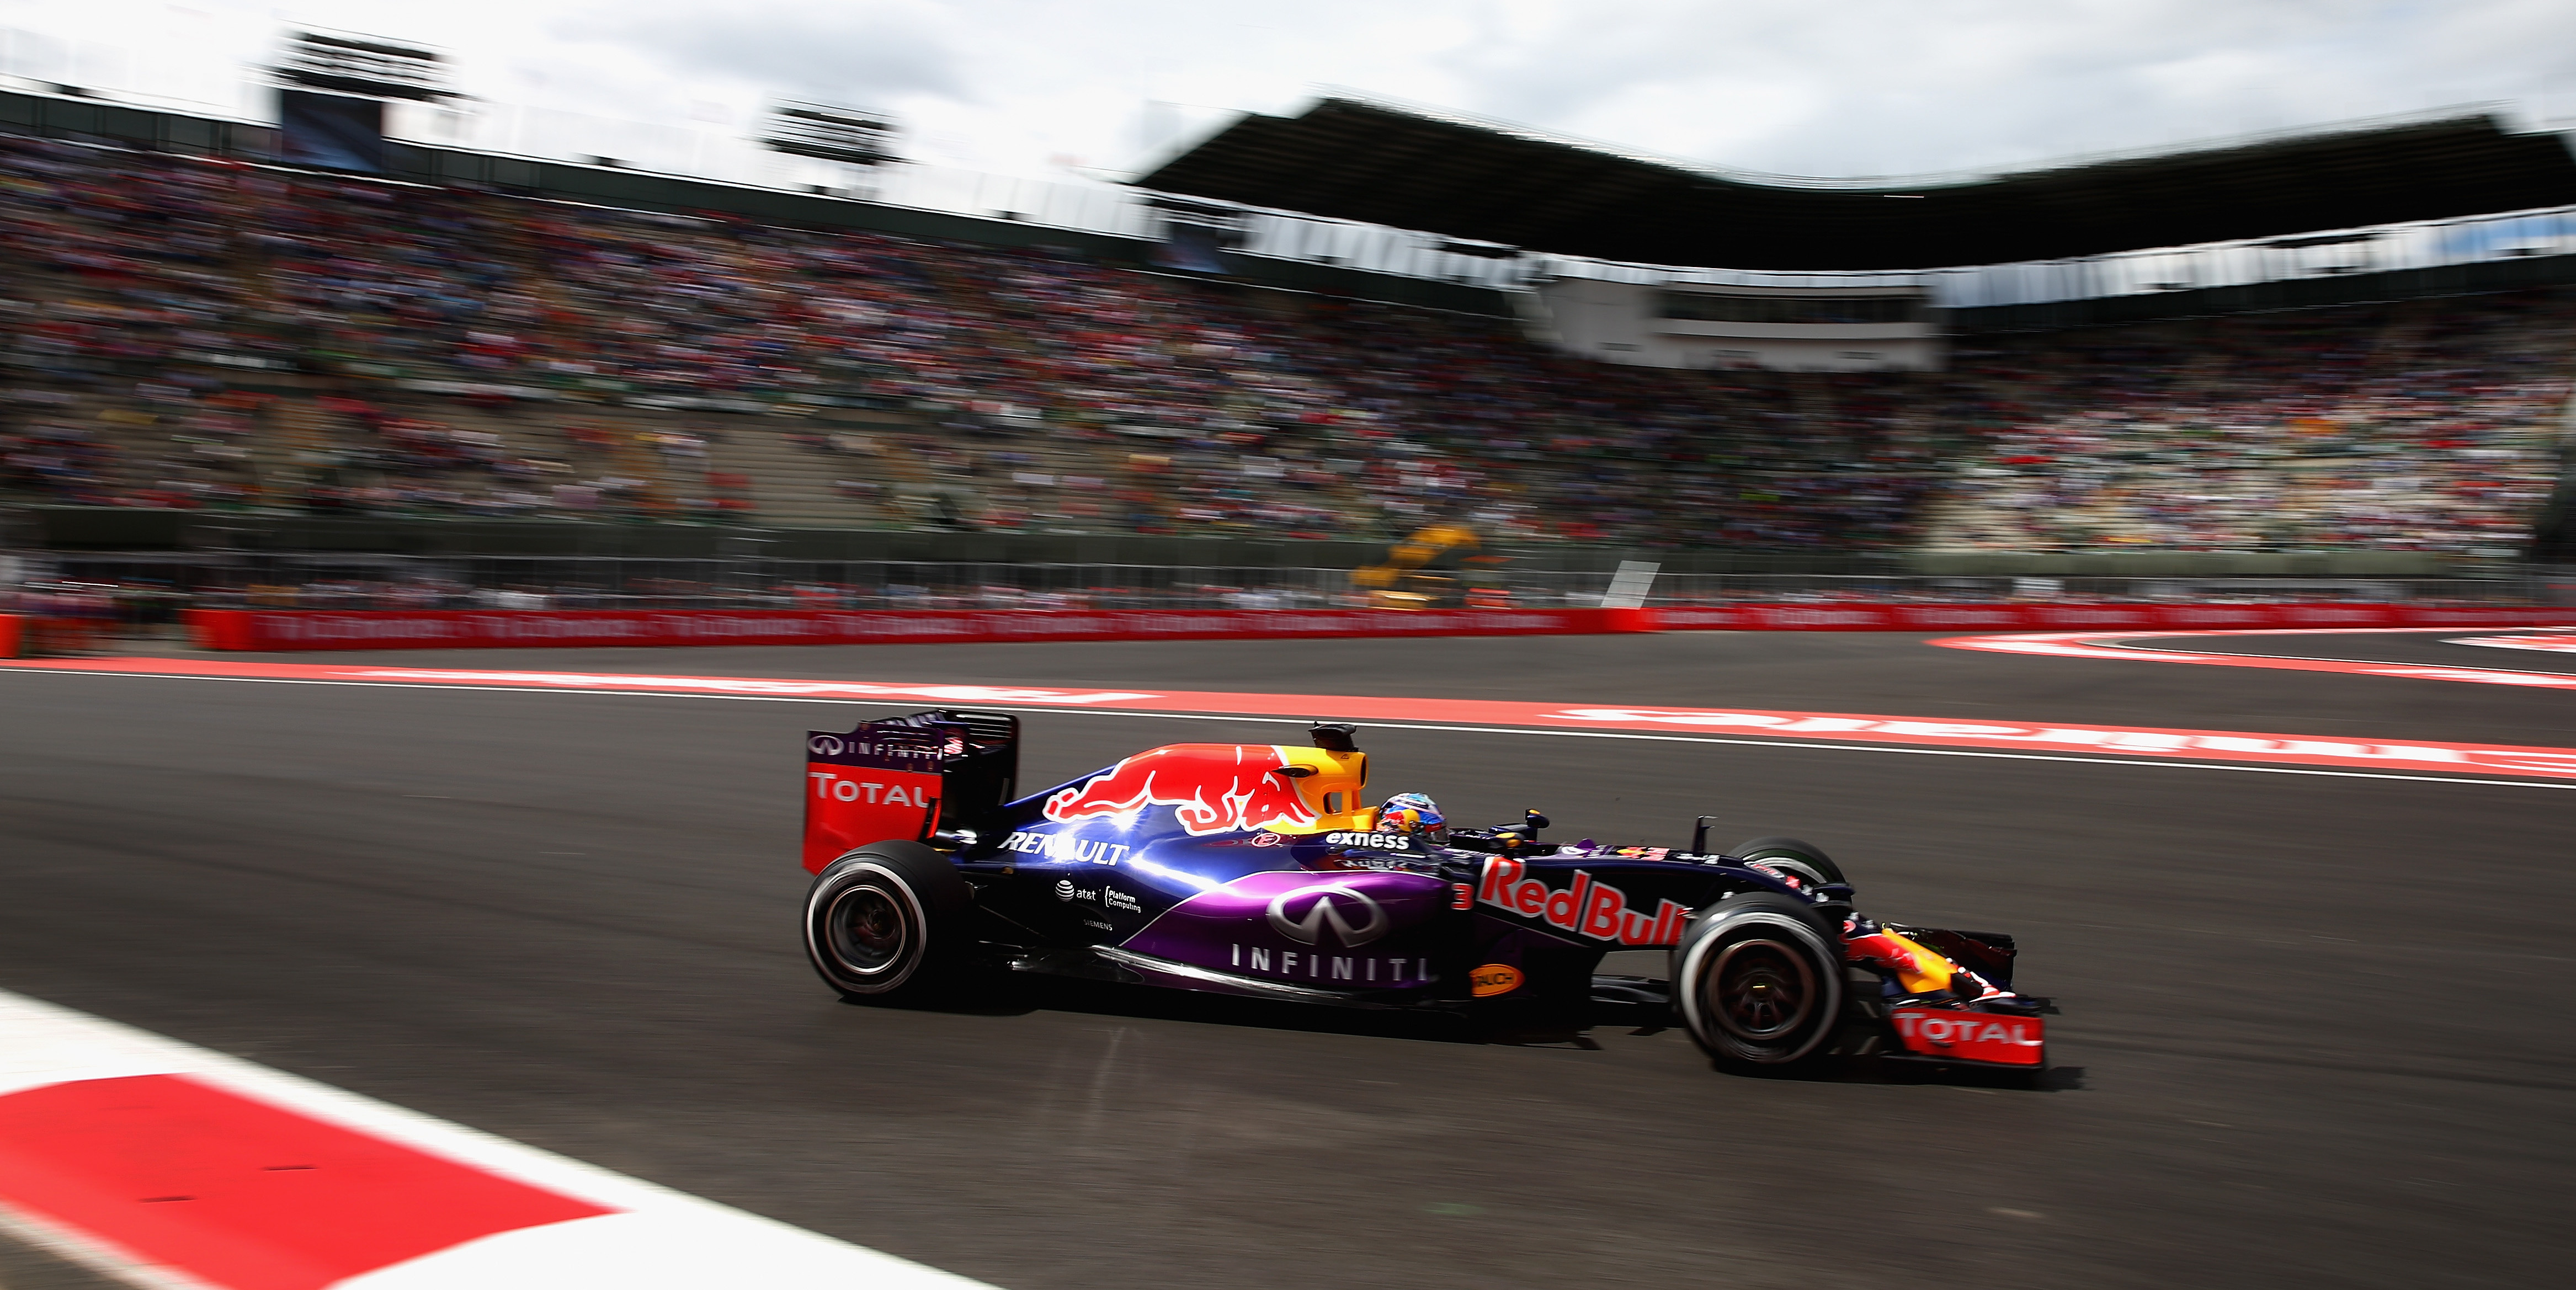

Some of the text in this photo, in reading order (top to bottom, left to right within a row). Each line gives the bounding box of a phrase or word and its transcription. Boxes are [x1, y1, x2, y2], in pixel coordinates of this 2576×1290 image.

[808, 772, 930, 808] TOTAL
[1326, 832, 1409, 850] exness
[1076, 889, 1096, 901] at&t
[1108, 890, 1136, 903] Platform
[1108, 898, 1141, 913] Computing
[1451, 883, 1475, 910] 3
[1478, 856, 1687, 945] Red Bull
[1083, 919, 1113, 931] SIEMENS
[1232, 943, 1427, 981] INFINITI
[1892, 1012, 2043, 1046] TOTAL
